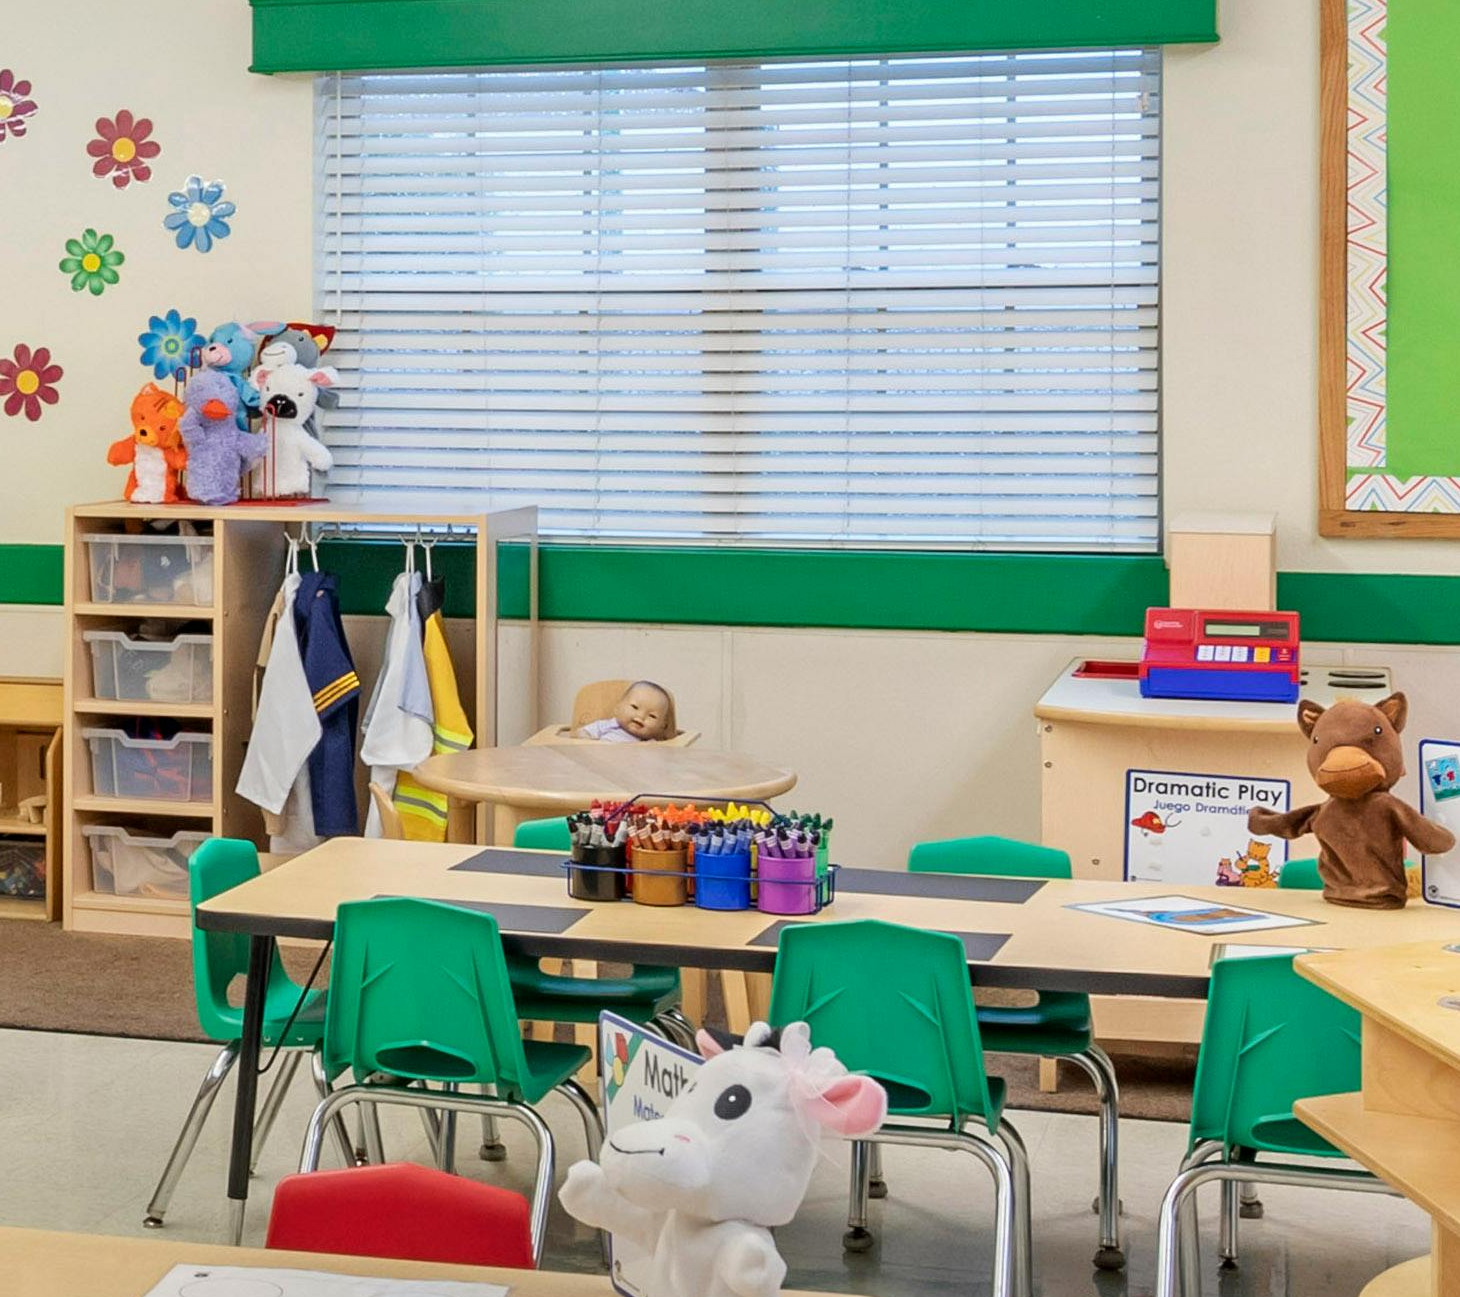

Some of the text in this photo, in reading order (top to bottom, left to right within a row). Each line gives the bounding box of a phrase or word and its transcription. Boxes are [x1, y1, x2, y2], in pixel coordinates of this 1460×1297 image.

[1134, 777, 1283, 806] Dramatic Play
[1153, 800, 1191, 814] Juego
